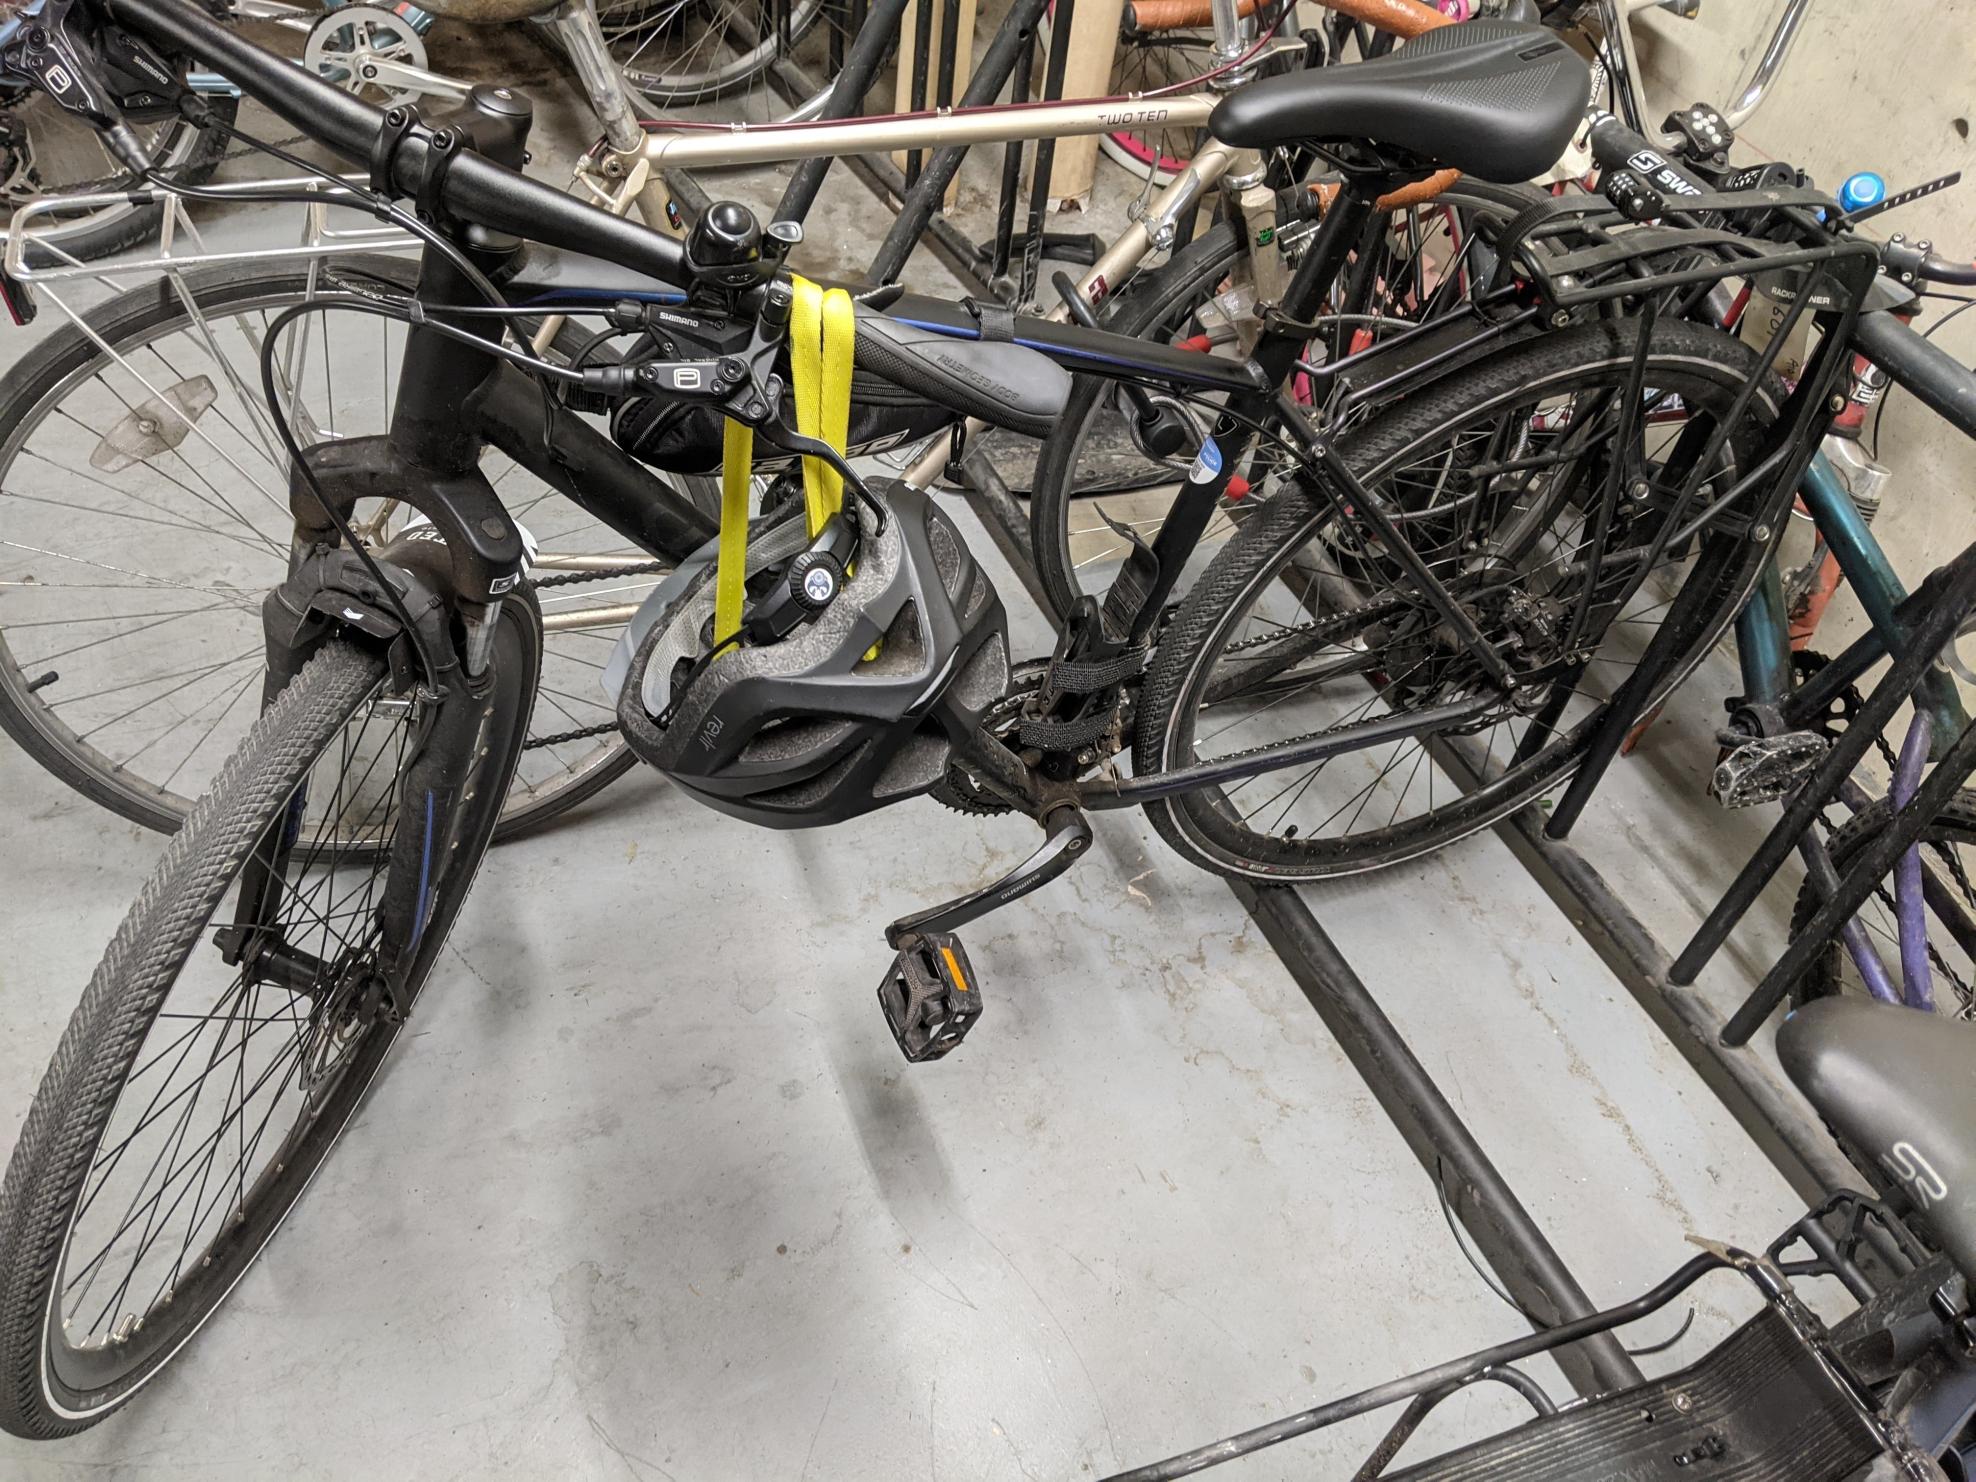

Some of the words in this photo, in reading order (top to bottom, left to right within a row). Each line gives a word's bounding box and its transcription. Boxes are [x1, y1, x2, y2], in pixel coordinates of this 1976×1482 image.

[133, 55, 169, 85] SHIMANO
[1098, 112, 1133, 127] TWO
[1138, 109, 1168, 123] TEN
[659, 311, 699, 328] SHIMANO
